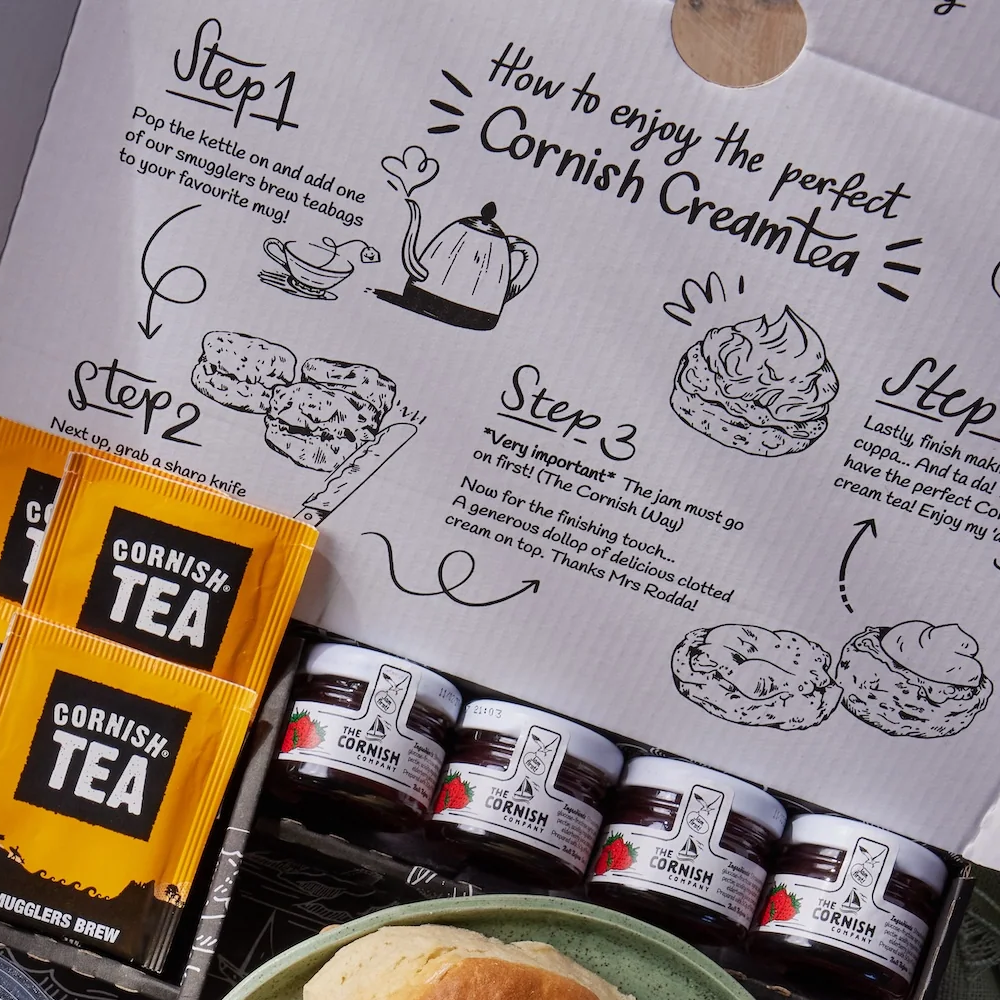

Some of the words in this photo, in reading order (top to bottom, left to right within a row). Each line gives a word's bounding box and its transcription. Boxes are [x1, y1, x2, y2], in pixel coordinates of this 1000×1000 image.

[132, 106, 165, 131] Pop
[169, 119, 195, 140] the
[198, 130, 246, 159] kettle
[249, 154, 269, 169] on
[272, 162, 304, 180] and
[304, 173, 336, 192] add
[336, 186, 365, 203] one
[480, 105, 644, 203] Cornish
[489, 42, 565, 99] How
[571, 72, 600, 114] to
[610, 105, 702, 166] enjoy
[715, 121, 764, 172] the
[768, 162, 911, 219] perfect
[120, 148, 135, 165] to
[137, 160, 176, 179] your
[179, 170, 249, 208] favourite
[252, 202, 290, 224] mug!
[125, 130, 145, 144] of
[146, 139, 174, 155] our
[175, 150, 256, 187] smugglers
[259, 176, 298, 203] brew
[303, 192, 363, 226] teabags
[501, 364, 601, 437] Step
[600, 424, 636, 461] 3
[882, 357, 996, 436] Step
[50, 416, 89, 440] Next
[91, 435, 111, 452] up,
[114, 443, 149, 462] grab
[152, 458, 161, 468] a
[209, 474, 246, 498] knife
[864, 415, 914, 448] Lastly,
[920, 434, 961, 460] finish
[473, 450, 492, 464] on
[496, 454, 535, 479] first!
[537, 468, 573, 492] (The
[576, 485, 637, 515] Cornish
[641, 506, 684, 533] Way)
[844, 454, 881, 477] have
[885, 468, 911, 487] the
[911, 482, 972, 509] perfect
[854, 439, 910, 467] cuppa...
[914, 458, 952, 478] And
[953, 468, 968, 486] ta
[971, 476, 997, 494] da!
[460, 476, 498, 498] Now
[502, 490, 526, 508] for
[529, 499, 554, 518] the
[557, 510, 618, 544] finishing
[623, 533, 675, 563] touch...
[624, 477, 653, 498] The
[650, 489, 681, 510] jam
[684, 504, 723, 524] must
[722, 518, 744, 530] go
[834, 478, 882, 501] cream
[886, 491, 917, 513] tea!
[918, 503, 963, 531] Enjoy
[964, 523, 988, 540] my
[445, 516, 491, 539] cream
[494, 533, 513, 546] on
[518, 537, 544, 558] top.
[552, 549, 605, 578] Thanks
[608, 570, 641, 591] Mrs
[644, 583, 699, 611] Rodda!
[452, 495, 466, 509] A
[468, 504, 539, 534] generous
[542, 526, 588, 553] dollop
[591, 546, 611, 558] of
[610, 551, 675, 582] delicious
[677, 576, 735, 603] clotted
[109, 565, 212, 648] TEA
[337, 734, 400, 766] CORNISH
[342, 726, 362, 740] THE
[52, 729, 155, 816] TEA
[356, 754, 397, 773] COMPANY
[484, 795, 549, 827] CORNISH
[491, 786, 510, 799] THE
[503, 815, 545, 834] COMPANY
[649, 855, 714, 886] CORNISH
[655, 847, 674, 858] THE
[668, 874, 709, 893] COMPANY
[818, 898, 837, 910] THE
[73, 917, 120, 944] BREW
[812, 908, 876, 938] CORNISH
[831, 926, 872, 945] COMPANY
